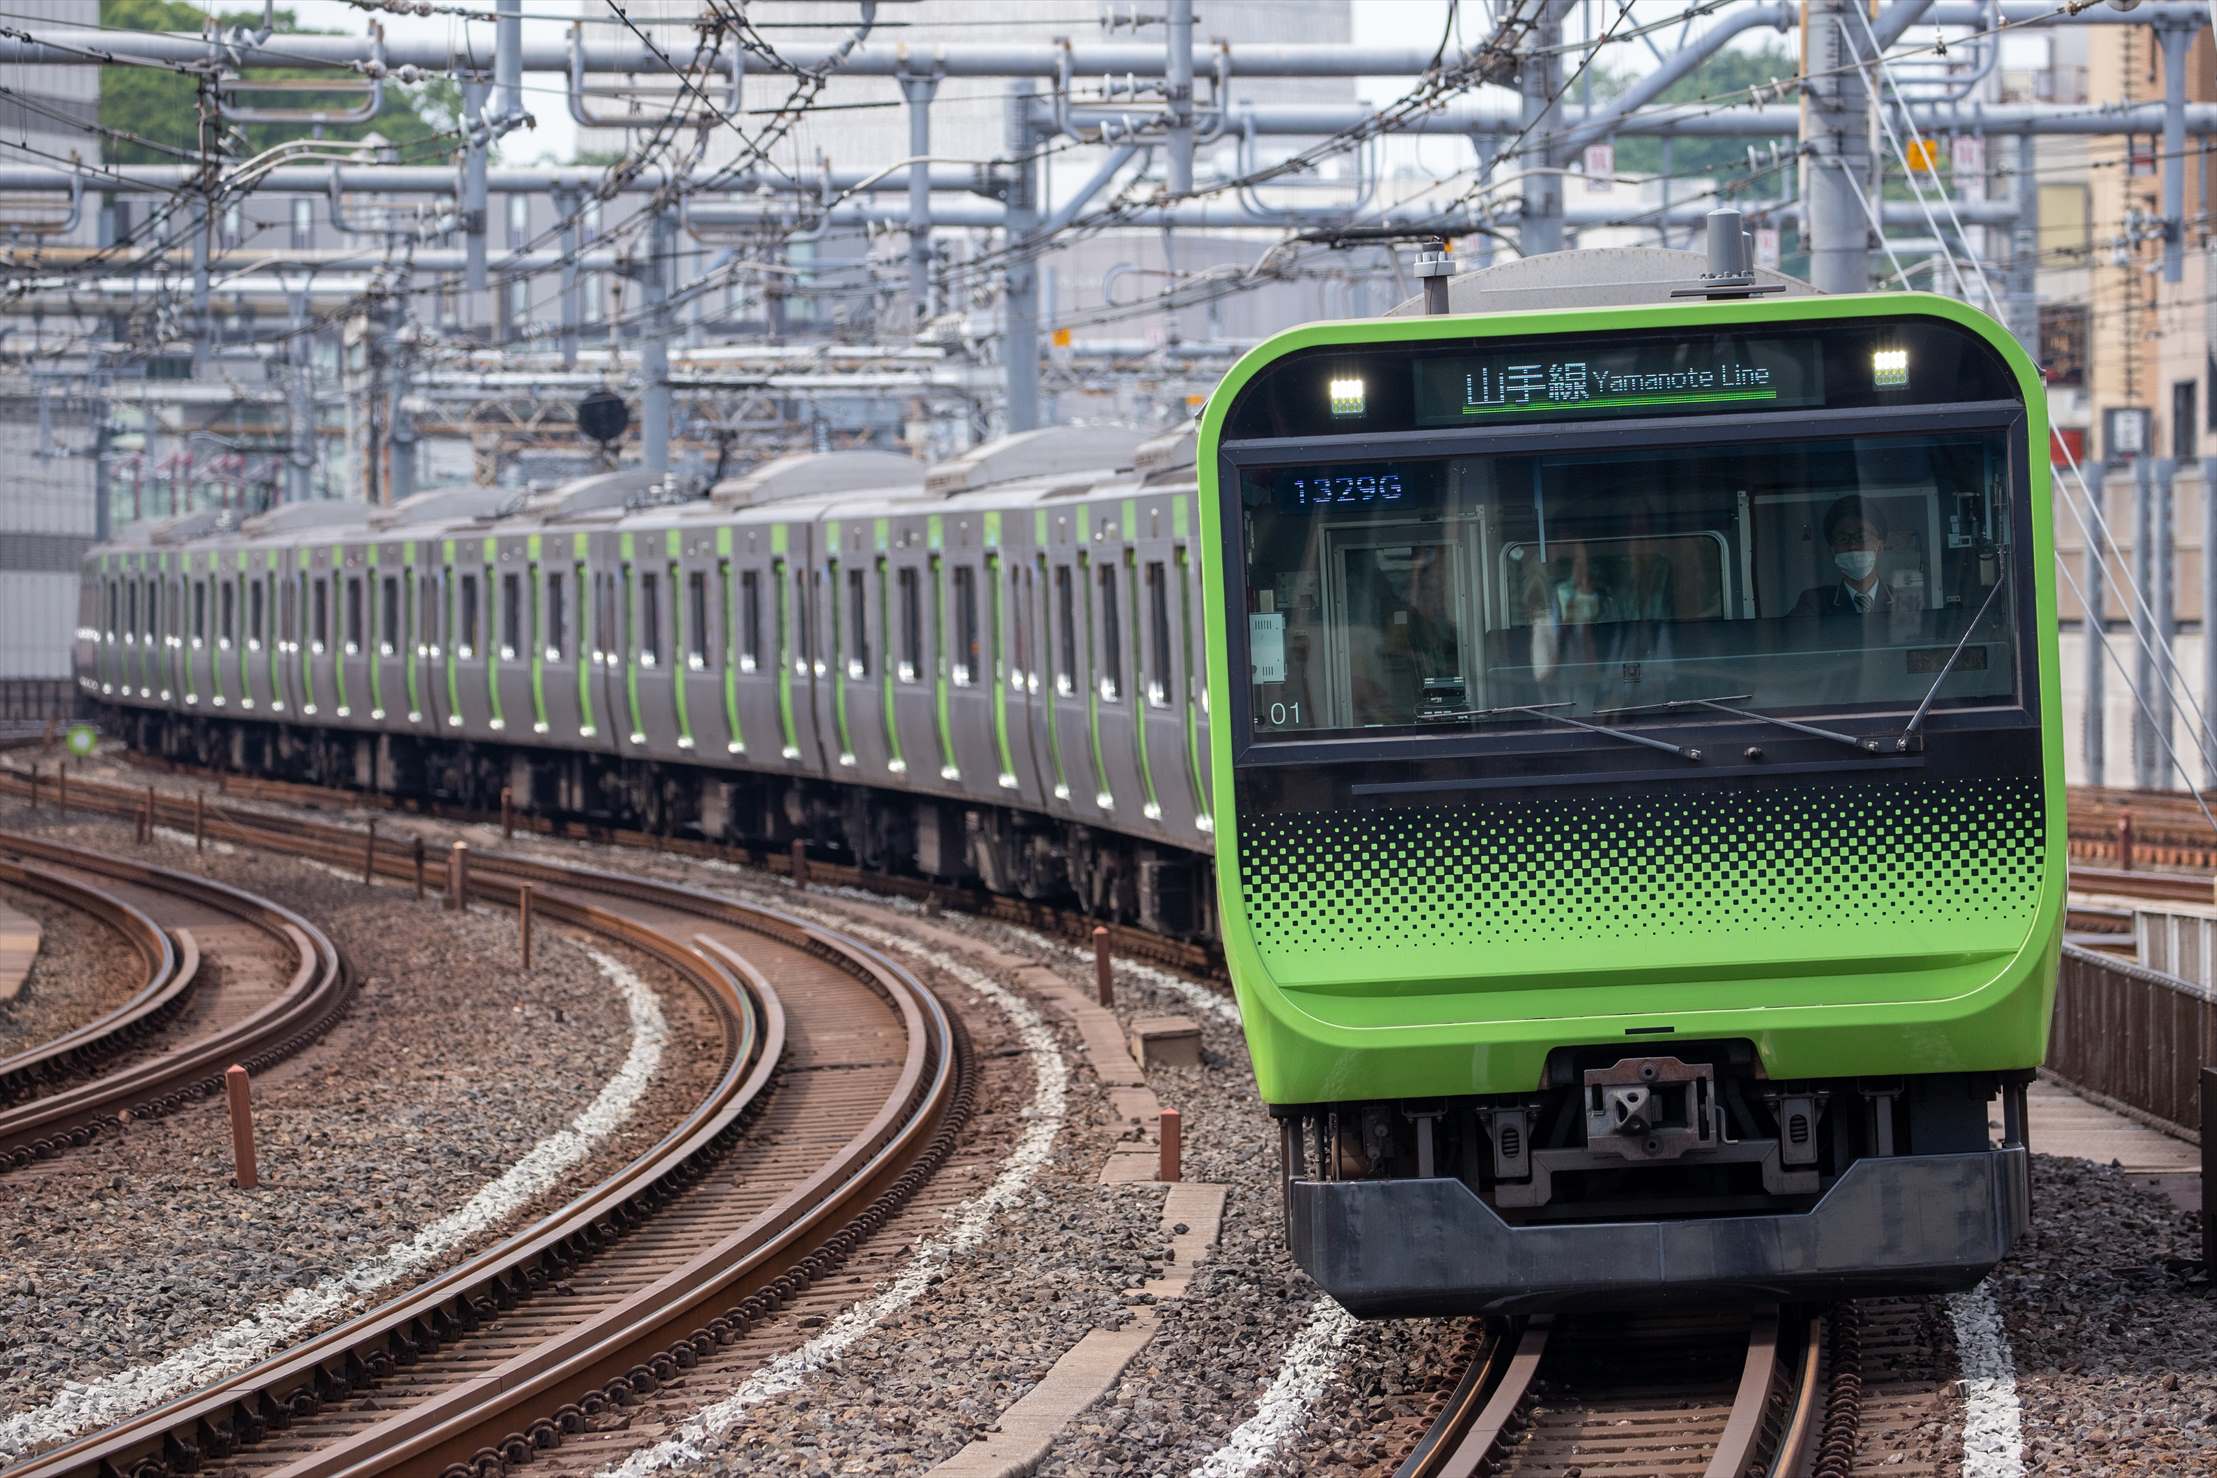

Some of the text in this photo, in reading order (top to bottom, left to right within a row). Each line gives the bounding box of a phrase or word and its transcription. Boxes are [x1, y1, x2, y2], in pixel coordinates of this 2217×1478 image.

[1466, 362, 1769, 405] 山手線 Yamanote Line
[1294, 475, 1401, 504] 1329G
[1270, 701, 1300, 725] 01
